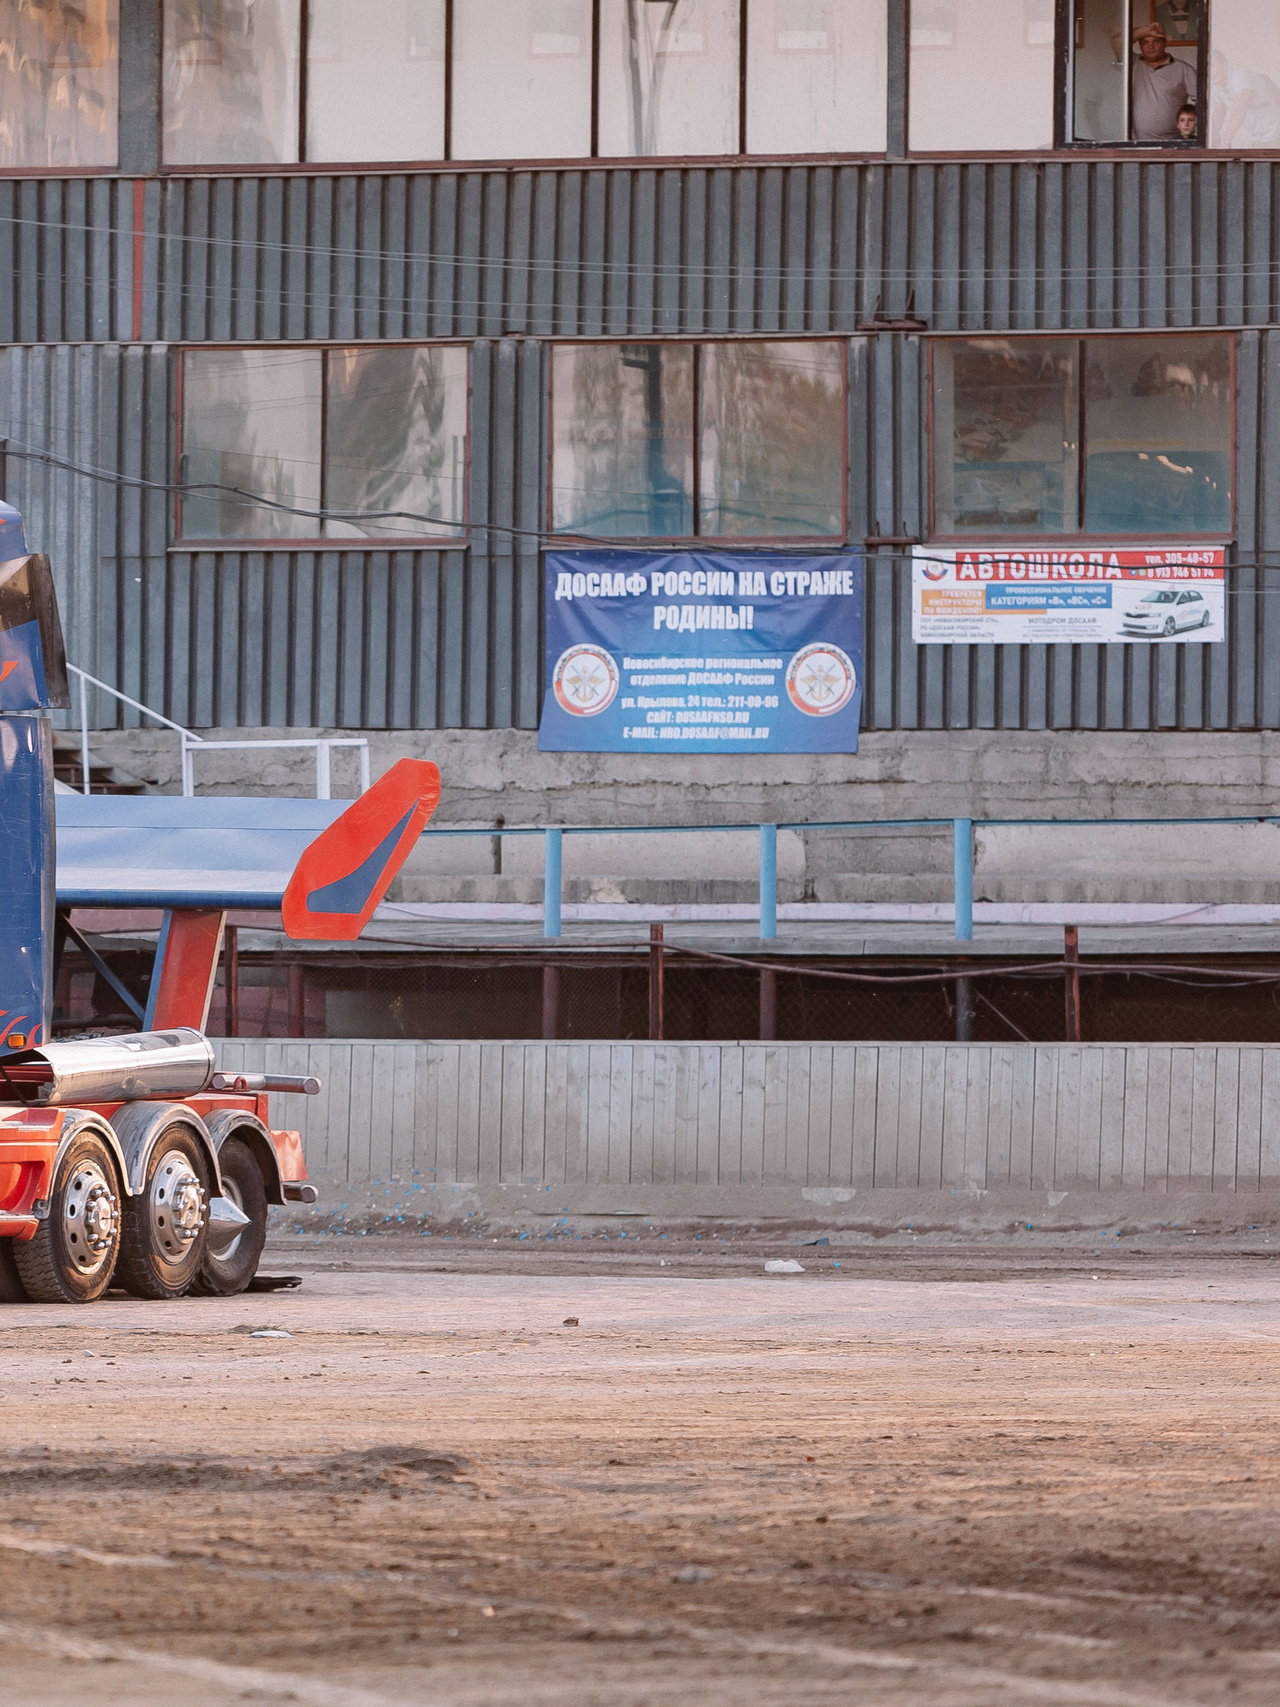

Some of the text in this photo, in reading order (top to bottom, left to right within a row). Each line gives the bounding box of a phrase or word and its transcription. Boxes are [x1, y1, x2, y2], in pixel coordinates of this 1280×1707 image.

[959, 553, 1123, 579] АВТОШКОЛА
[1144, 555, 1163, 565] тел.
[555, 570, 854, 600] ДОСААФ РОССИИ НА СТРАЖЕ
[990, 597, 1047, 606] КАТЕГОРИЯМ
[653, 605, 754, 632] РОДИНЫ!
[623, 656, 783, 670] Новосибирское региональное
[630, 672, 775, 687] отделение ДОСААФ России
[621, 697, 636, 709] ул.
[687, 695, 700, 707] 24
[728, 695, 779, 708] 211-00-96
[646, 710, 674, 723] САЙТ:
[623, 726, 658, 739] E-MAIL:
